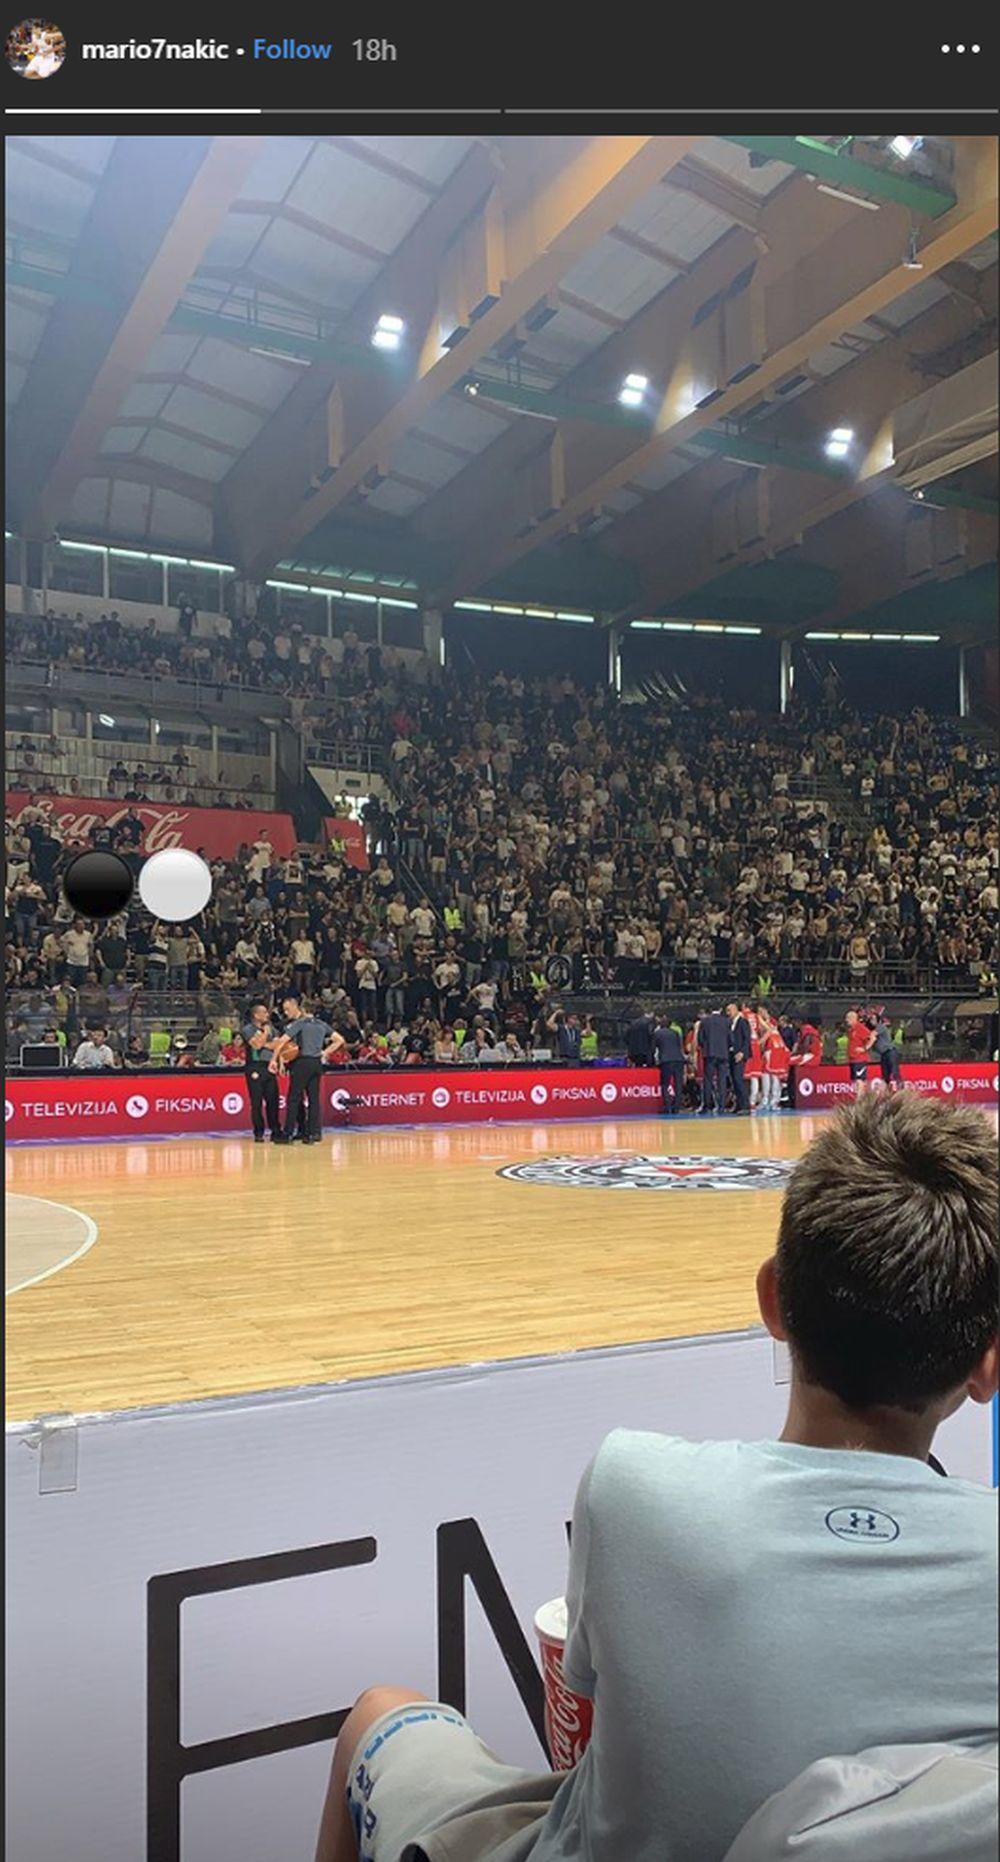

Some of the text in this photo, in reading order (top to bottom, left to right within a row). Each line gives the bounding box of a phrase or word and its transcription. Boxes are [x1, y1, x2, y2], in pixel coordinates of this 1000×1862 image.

[956, 1079, 990, 1089] FIKSNA
[455, 1089, 526, 1104] TELEVIZIJA
[551, 1087, 597, 1100] FIKSNA
[21, 1098, 216, 1118] TELEVIZIJA FIKSNA
